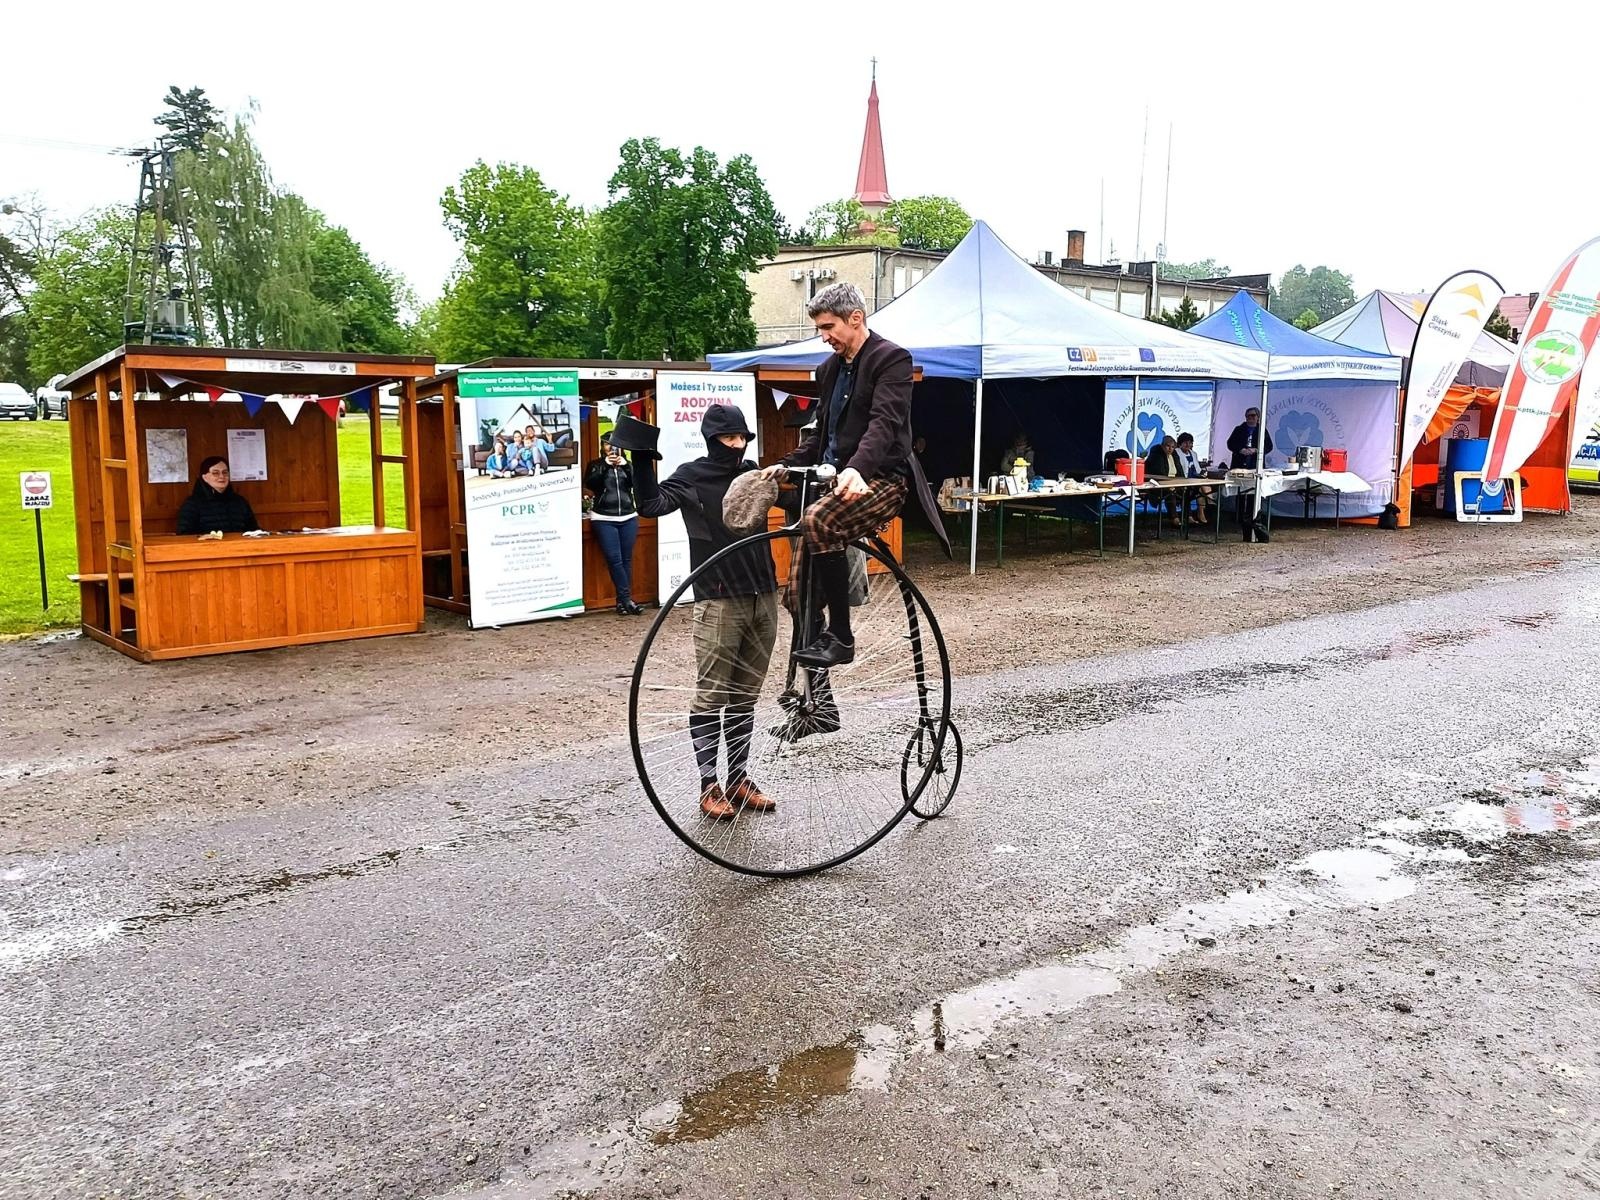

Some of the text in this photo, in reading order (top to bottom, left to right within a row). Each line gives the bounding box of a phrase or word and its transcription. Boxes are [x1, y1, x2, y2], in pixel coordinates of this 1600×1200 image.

[670, 381, 701, 391] Możesz
[707, 383, 716, 393] Ty
[718, 383, 743, 392] zostać
[674, 411, 704, 422] ZAST
[502, 503, 536, 517] PCPR
